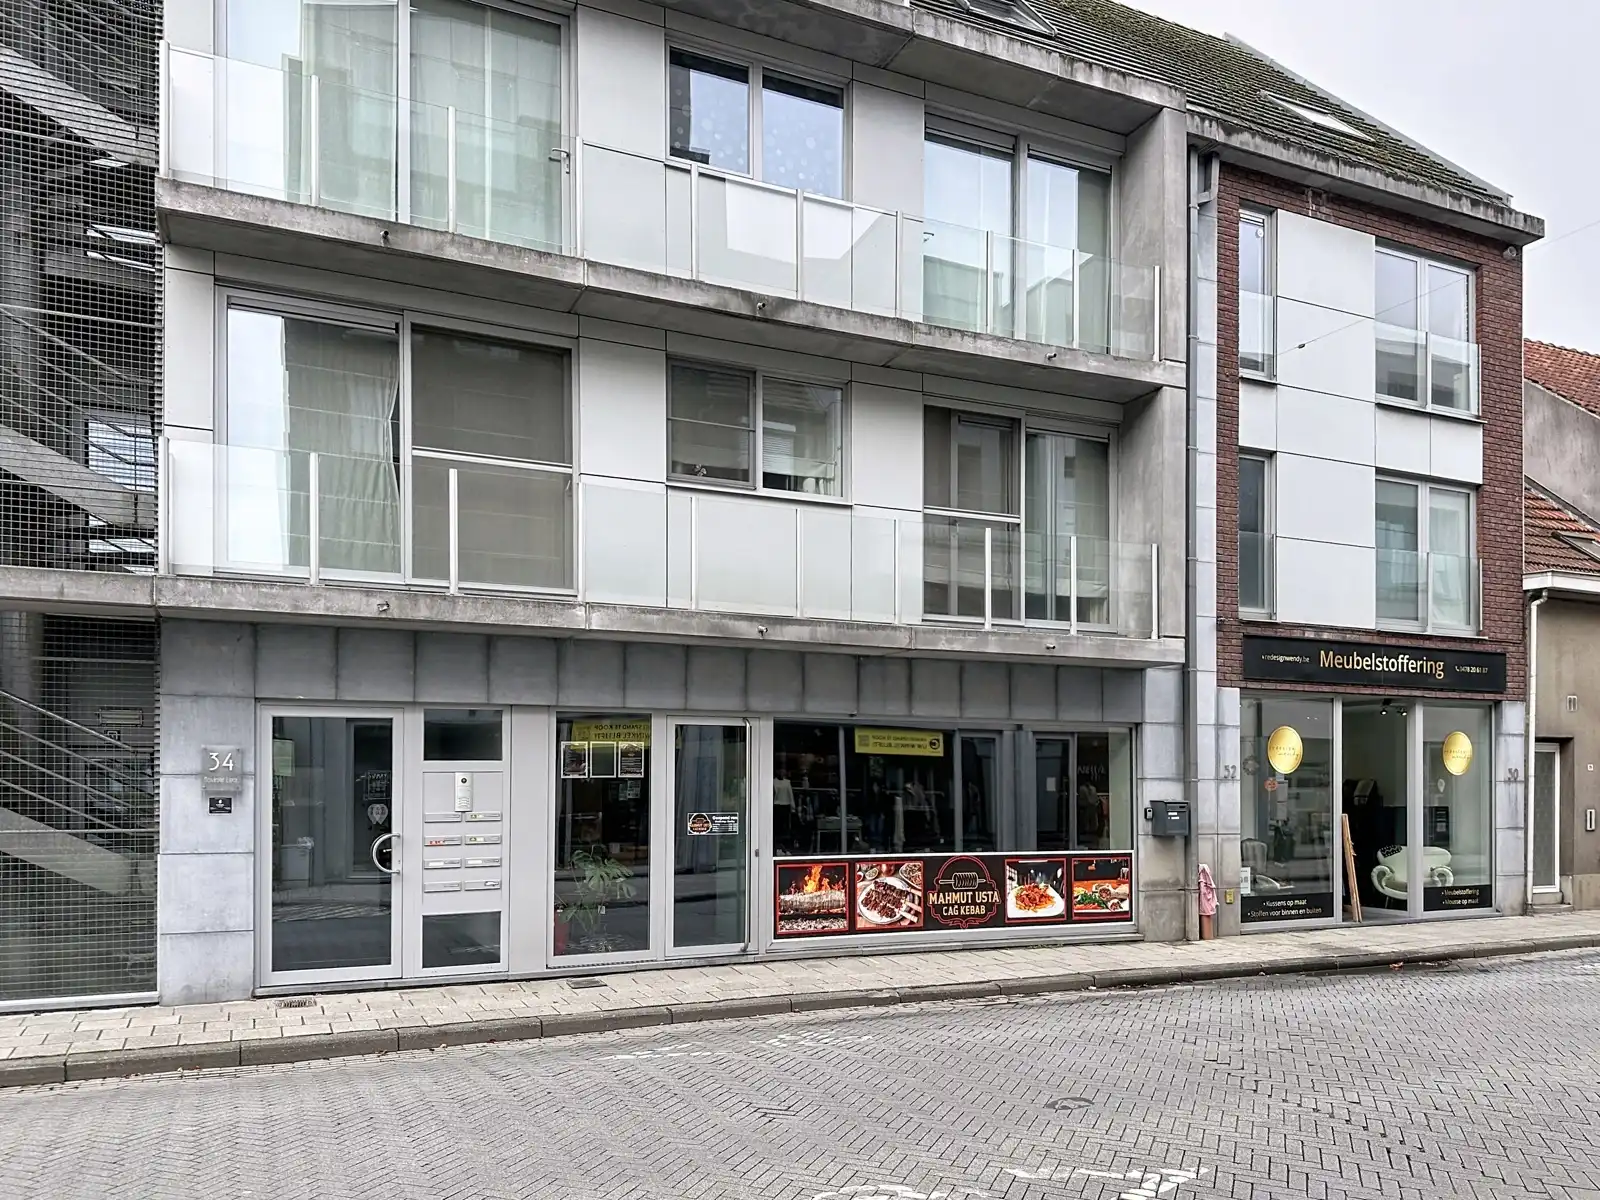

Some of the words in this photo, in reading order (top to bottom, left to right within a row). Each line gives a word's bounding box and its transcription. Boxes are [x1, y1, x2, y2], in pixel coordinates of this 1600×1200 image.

[1264, 654, 1310, 663] redesignwendy.be
[1320, 650, 1444, 679] Meubelstoffering
[209, 752, 233, 771] 34
[1224, 765, 1236, 778] 52
[1508, 768, 1519, 780] 50
[929, 891, 973, 904] MAHMUT
[976, 891, 1000, 903] USTA
[960, 905, 986, 915] KEBAB
